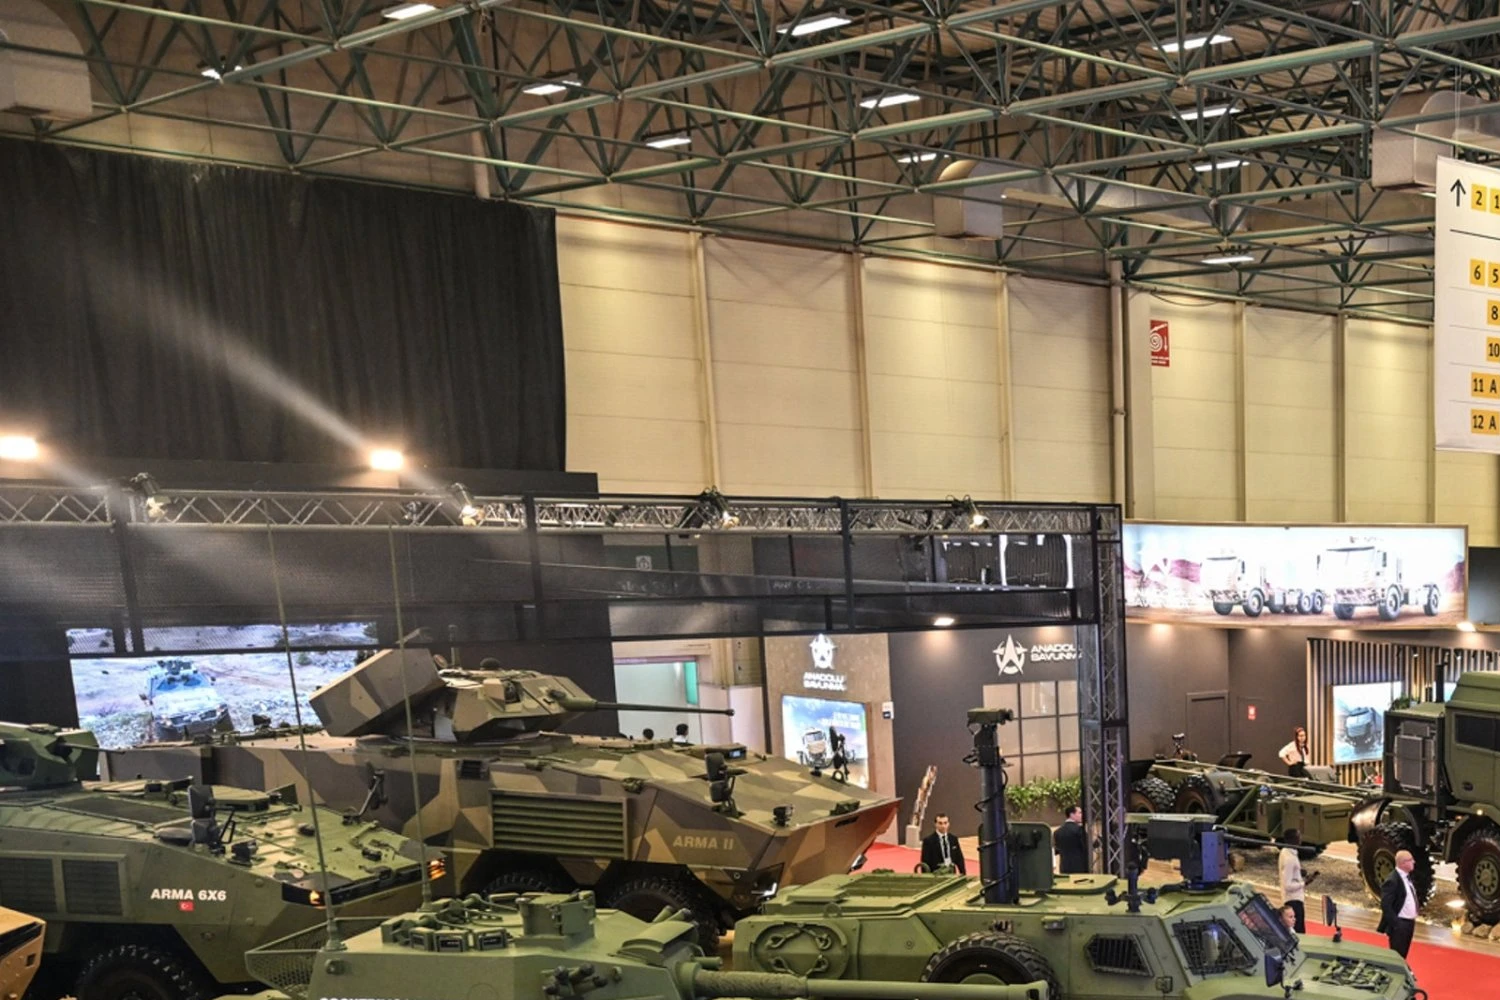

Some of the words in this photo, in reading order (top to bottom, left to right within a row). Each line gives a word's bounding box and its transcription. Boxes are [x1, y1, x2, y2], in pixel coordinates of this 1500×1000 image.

[1476, 190, 1483, 206] 2
[1494, 194, 1500, 209] 1
[1474, 265, 1481, 280] 6
[1492, 268, 1499, 283] 5
[1491, 305, 1499, 321] 8
[1488, 342, 1500, 358] 10
[1473, 378, 1484, 393] 11
[1489, 379, 1497, 394] A
[1472, 414, 1484, 429] 12
[1489, 415, 1497, 430] A
[673, 835, 718, 849] ARMA
[723, 838, 734, 850] II
[150, 888, 194, 900] ARMA
[198, 889, 227, 901] 6X6
